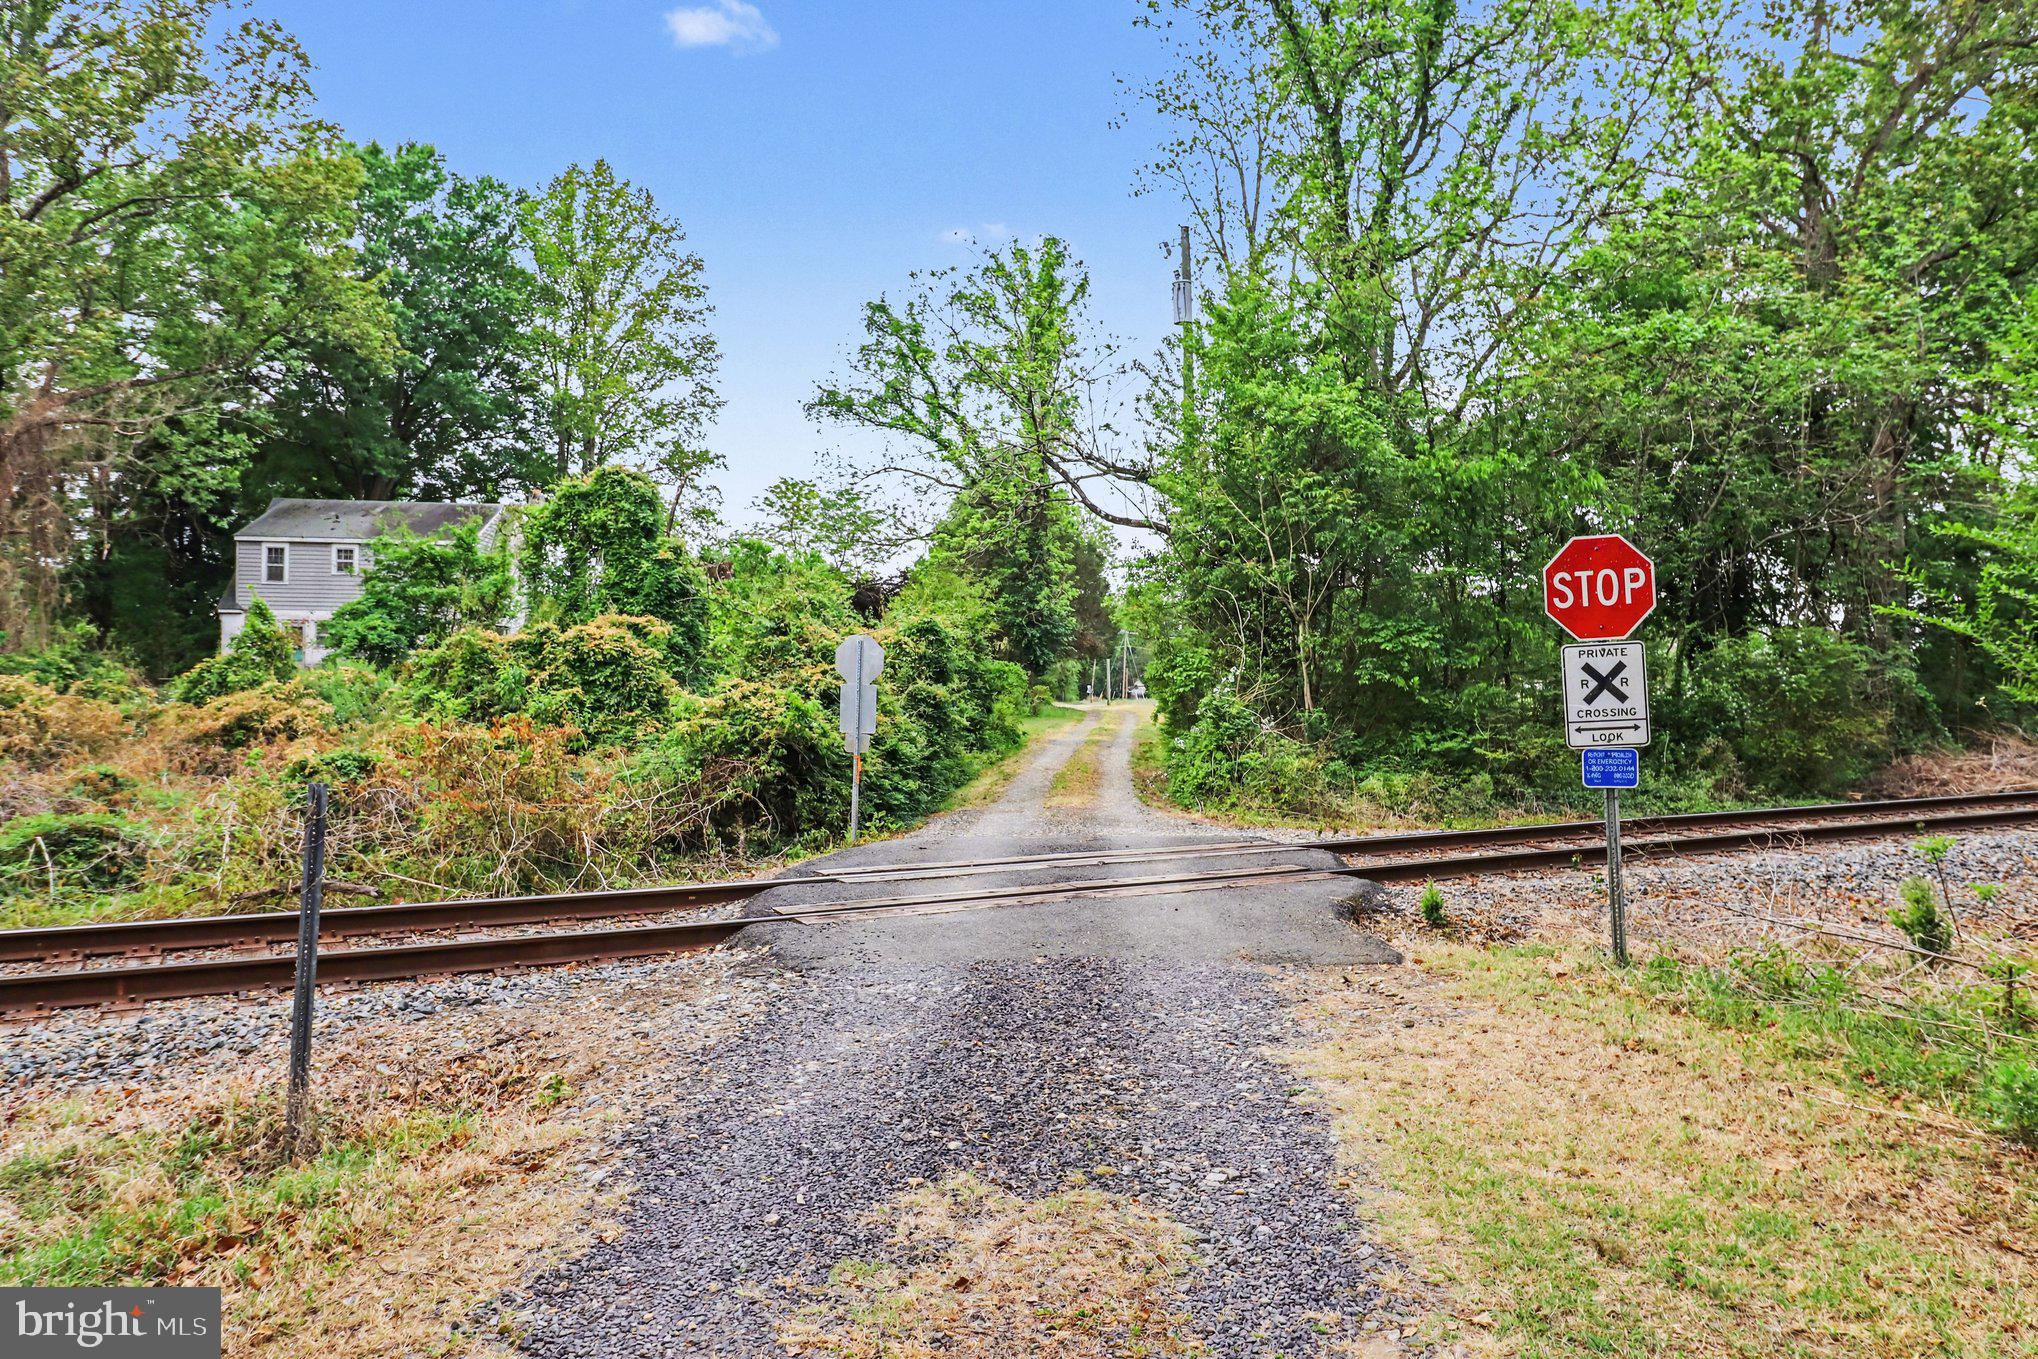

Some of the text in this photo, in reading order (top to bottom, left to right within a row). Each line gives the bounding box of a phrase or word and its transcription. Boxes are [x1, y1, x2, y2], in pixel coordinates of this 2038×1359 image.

[1553, 567, 1646, 609] STOP
[1578, 647, 1628, 658] PRIVATE
[1580, 677, 1629, 689] R R
[1576, 707, 1637, 719] CROSSING
[1592, 732, 1624, 742] LOOK
